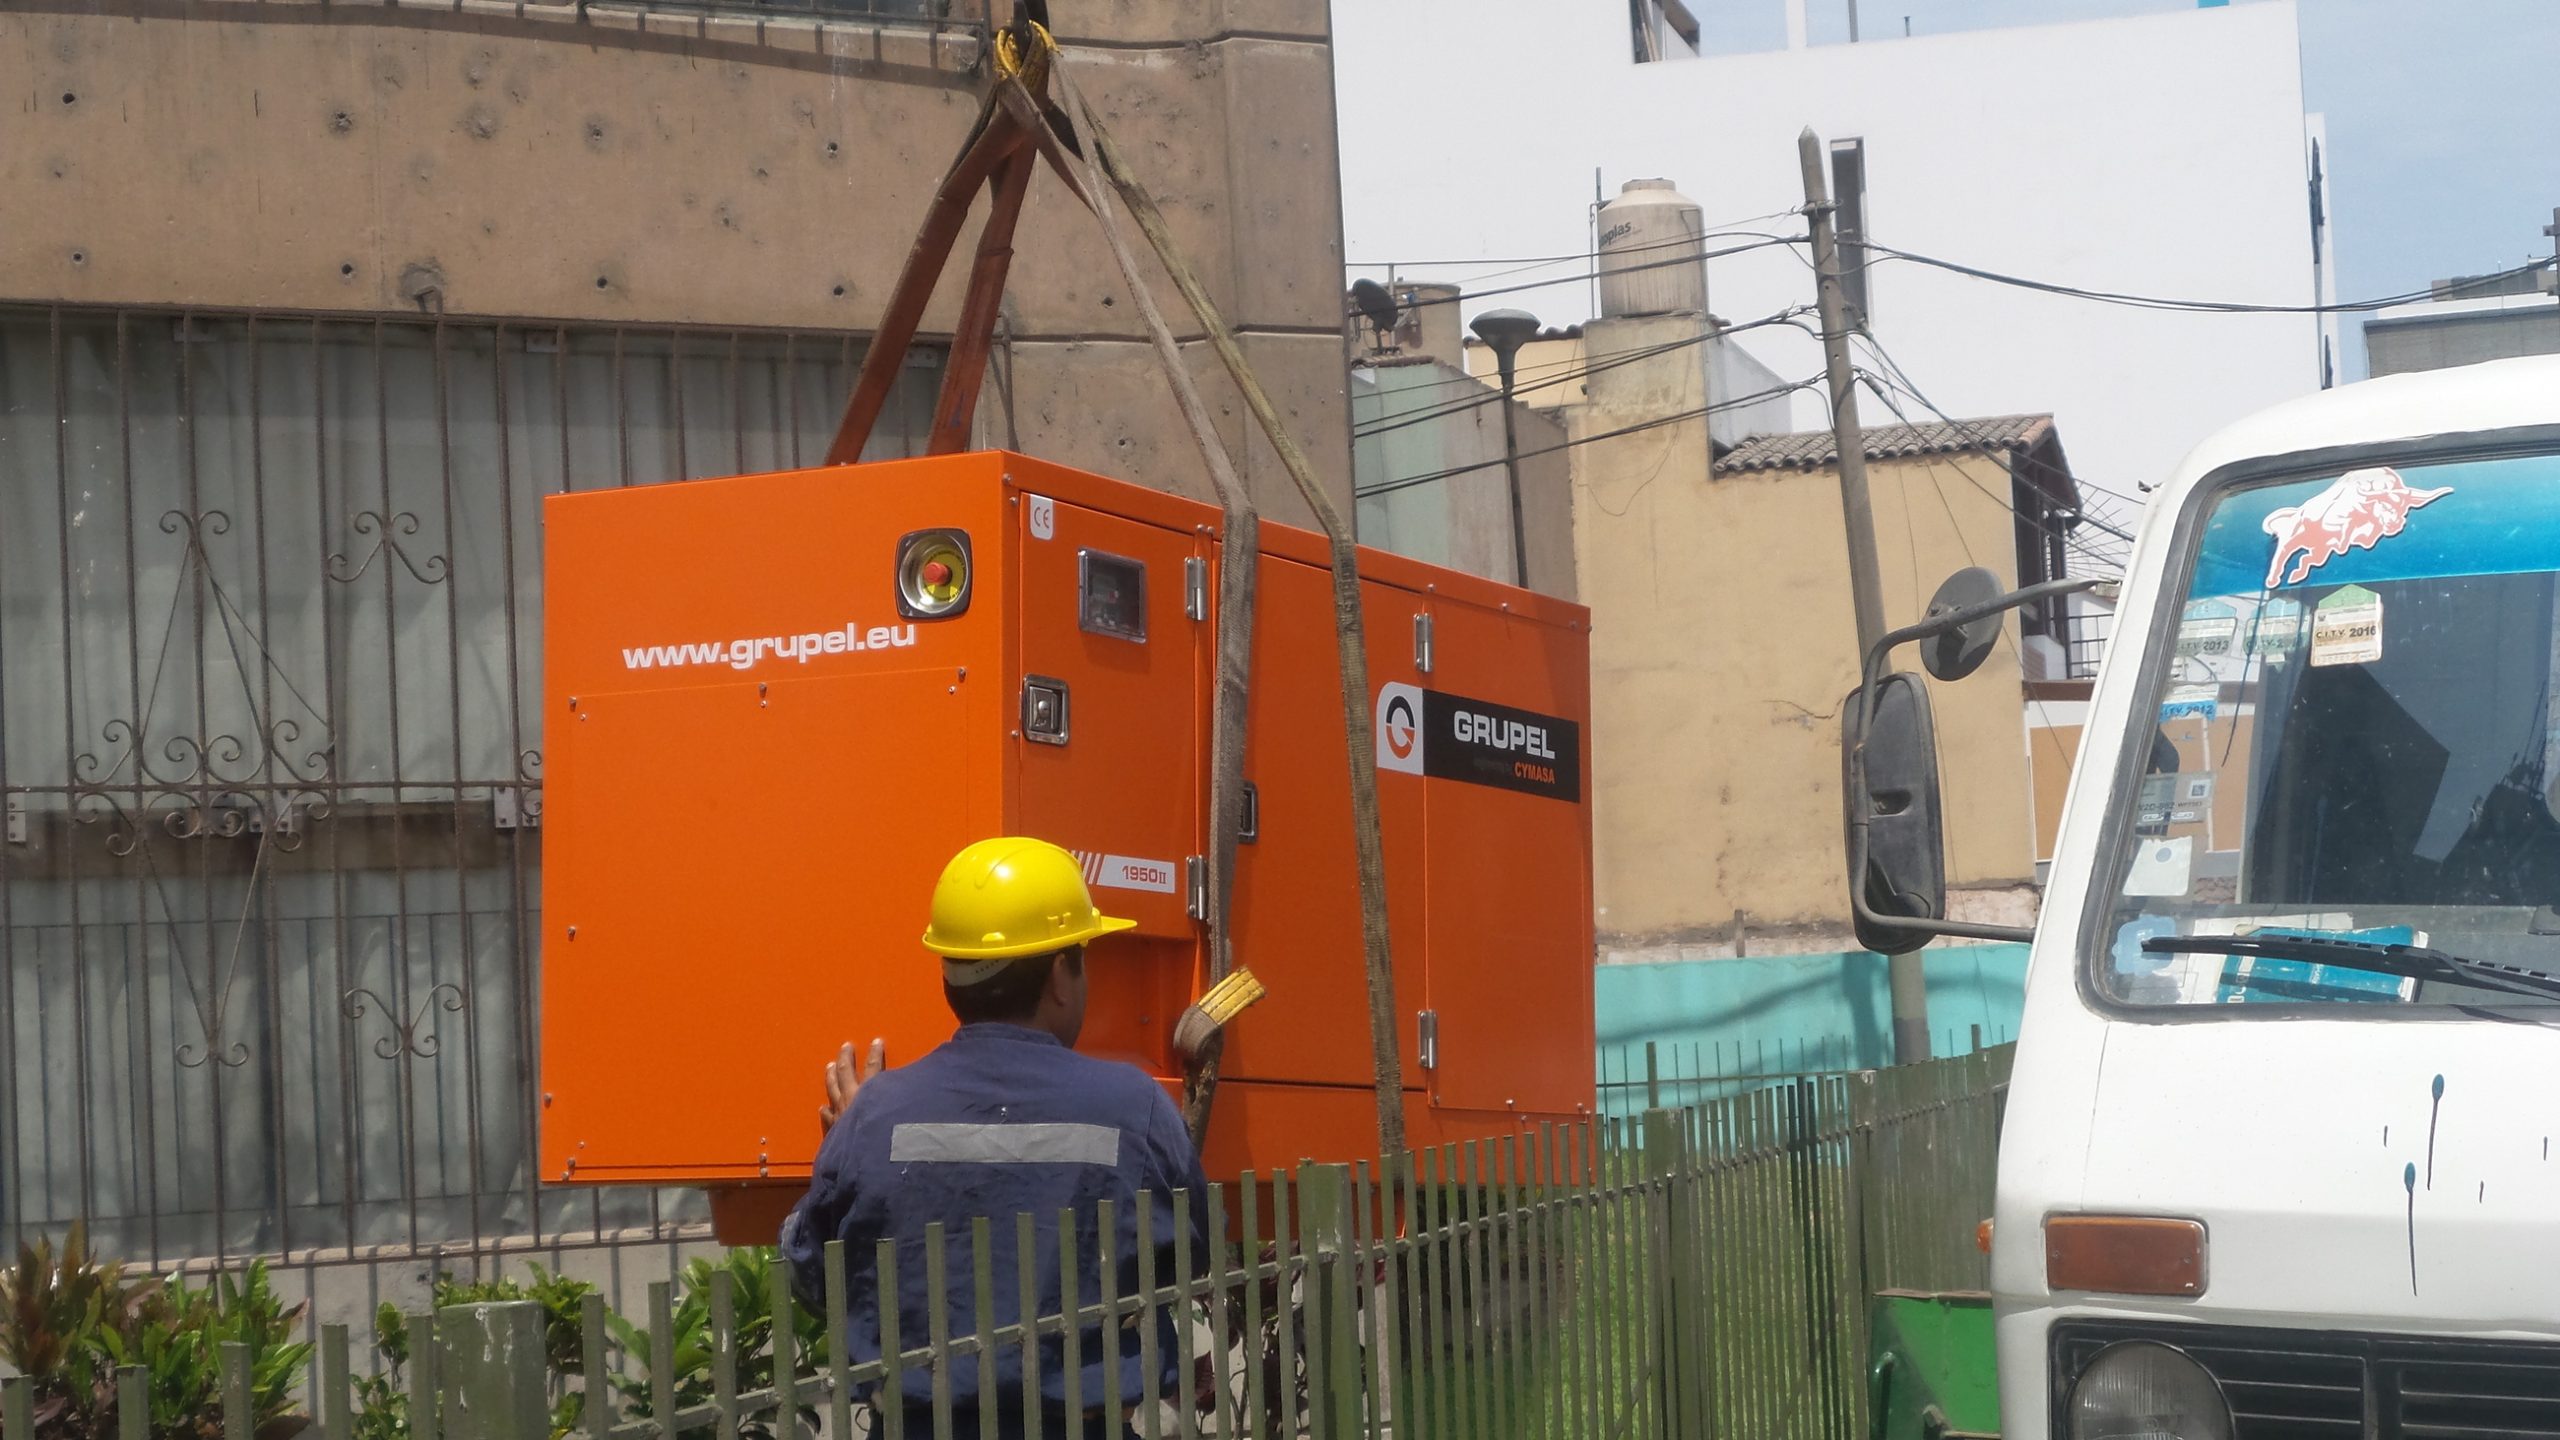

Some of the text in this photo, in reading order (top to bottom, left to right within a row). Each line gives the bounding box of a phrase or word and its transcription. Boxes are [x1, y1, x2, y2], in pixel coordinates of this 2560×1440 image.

[2349, 625, 2377, 638] 2016
[622, 622, 916, 670] www.grupel.eu
[2203, 640, 2230, 651] 2013
[1454, 710, 1556, 759] GRUPEL
[1514, 761, 1556, 784] CYMASA
